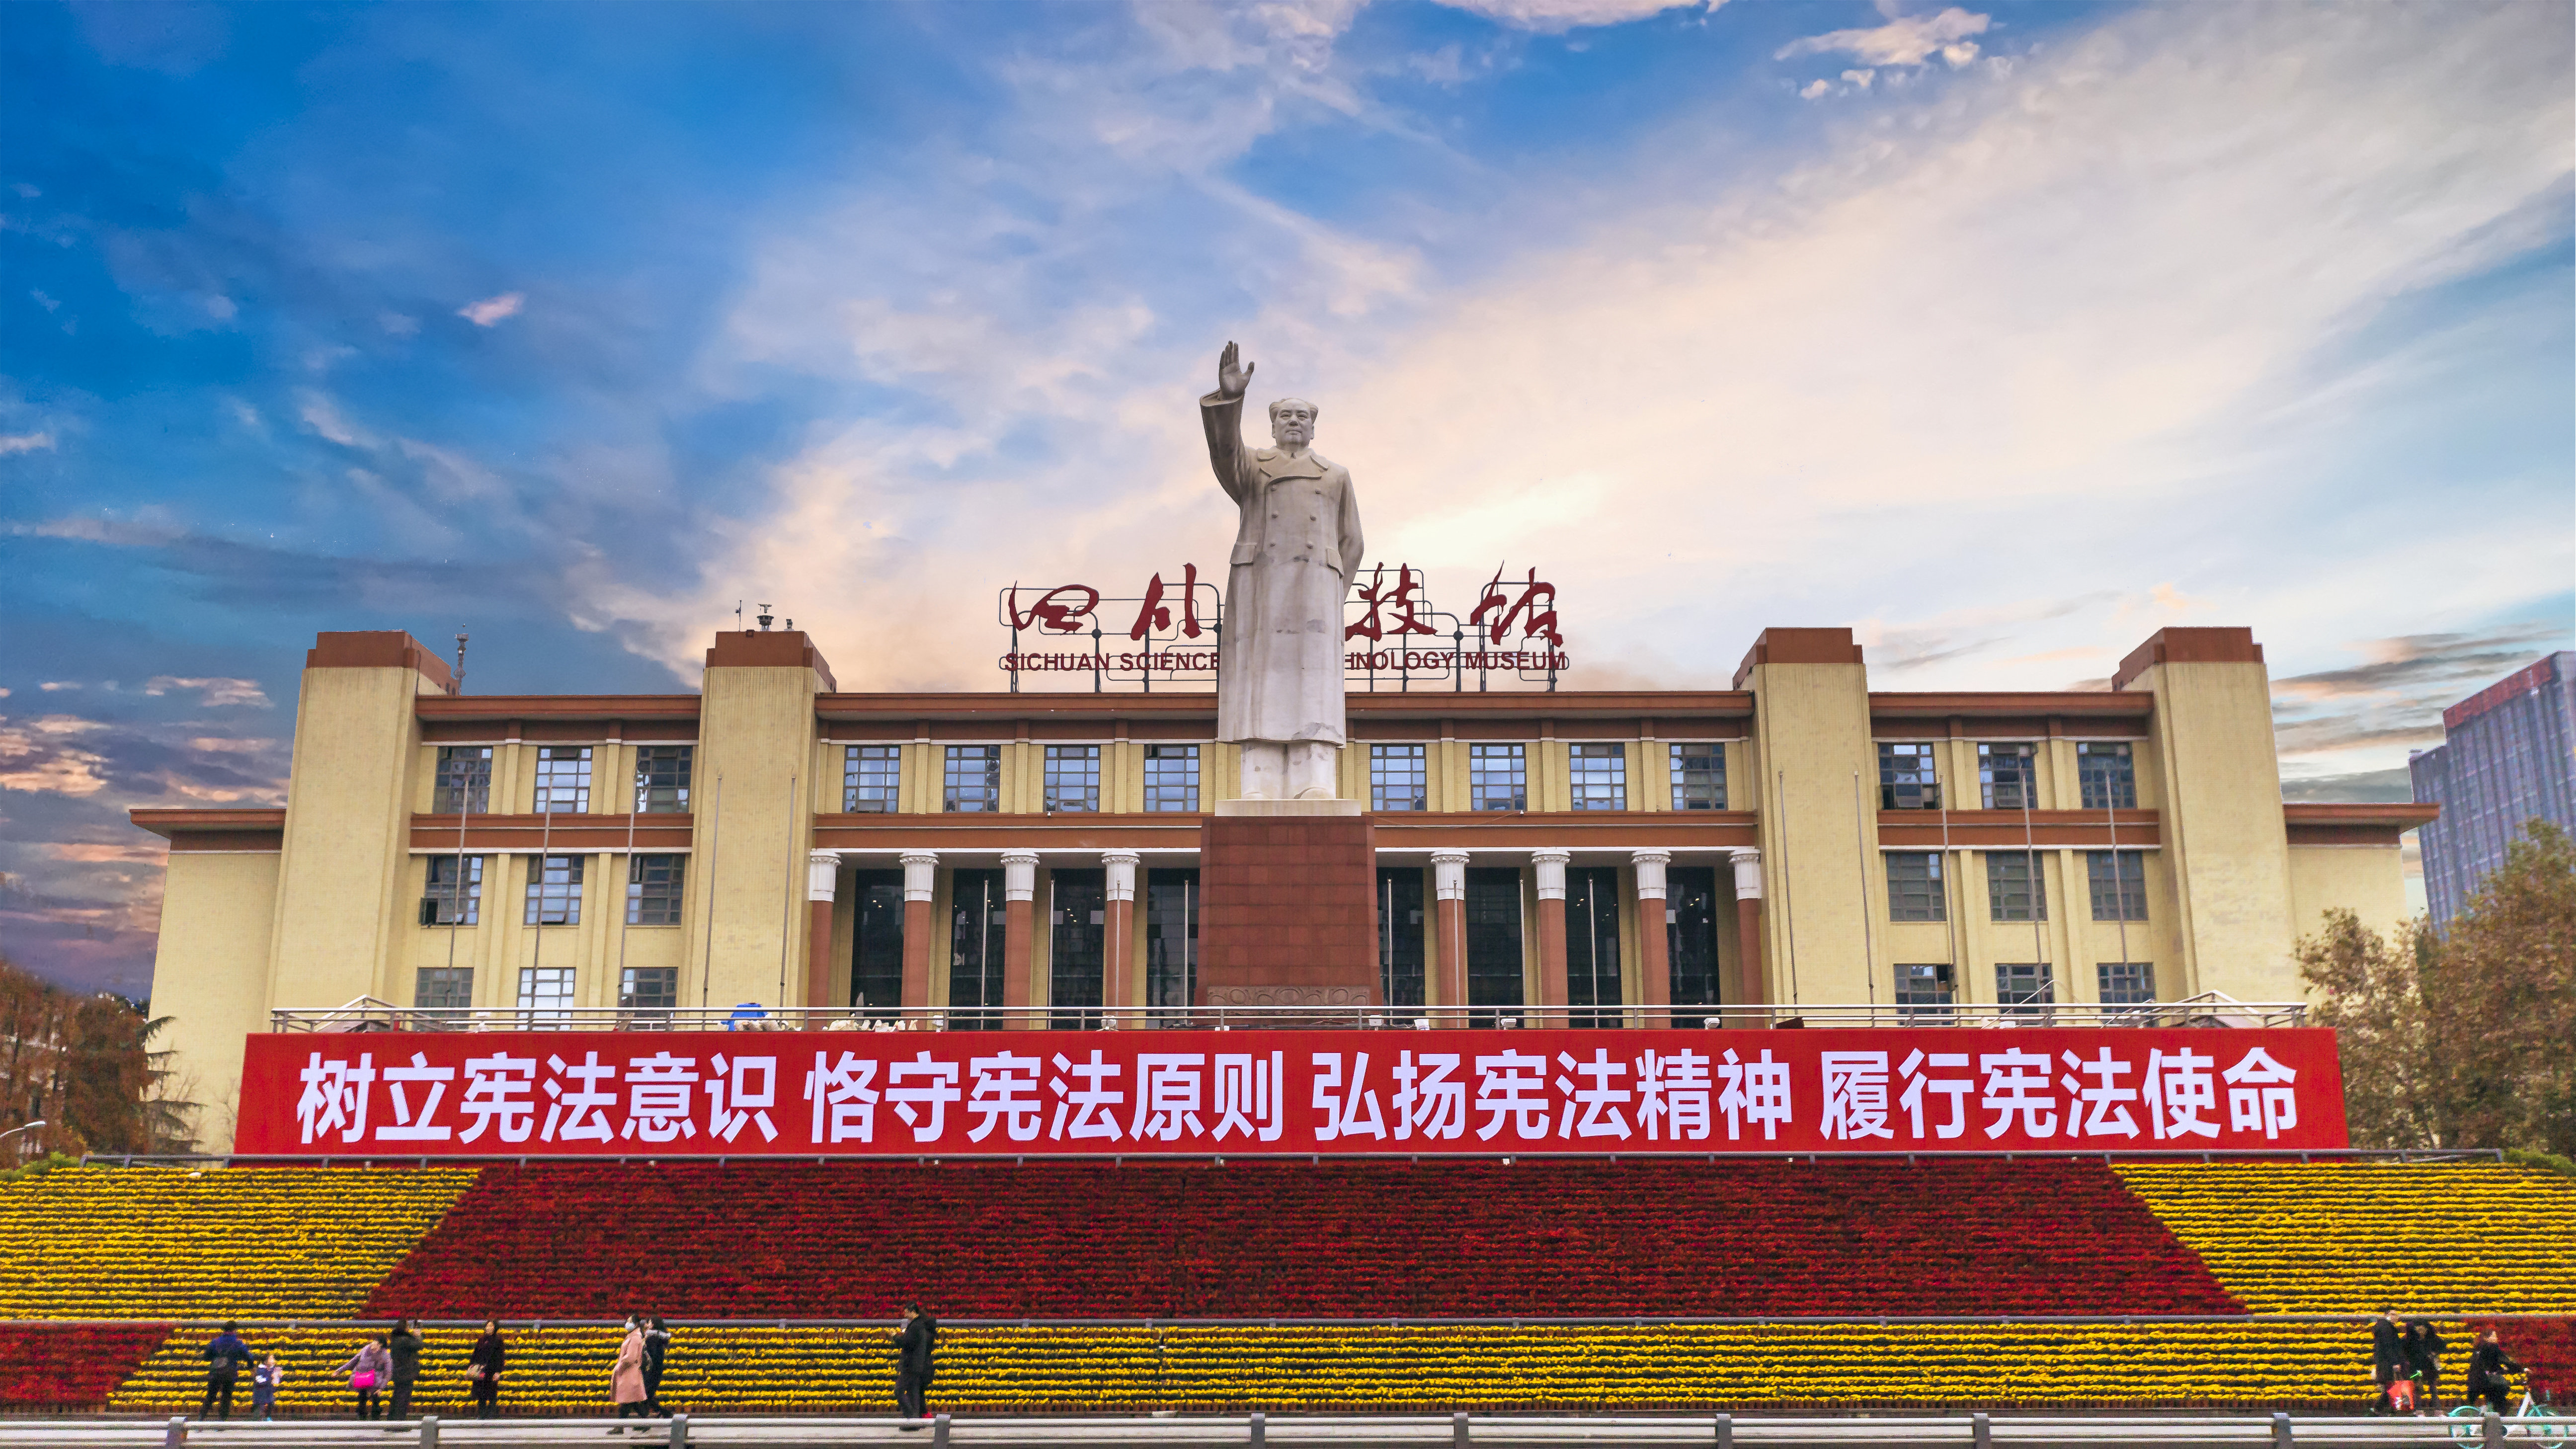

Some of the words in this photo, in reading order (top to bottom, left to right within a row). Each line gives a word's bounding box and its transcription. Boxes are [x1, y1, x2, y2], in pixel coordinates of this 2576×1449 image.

[1008, 560, 1564, 647] 四川技馆
[1004, 652, 1110, 671] SICHUAN
[1120, 652, 1220, 671] SCIENCE
[1465, 651, 1566, 669] MUSEUM
[297, 1051, 778, 1144] 树立宪法意识
[804, 1049, 1283, 1143] 恪守宪法原则
[1311, 1048, 1792, 1141] 弘扬宪法精神
[1819, 1046, 2298, 1140] 履行宪法使命
